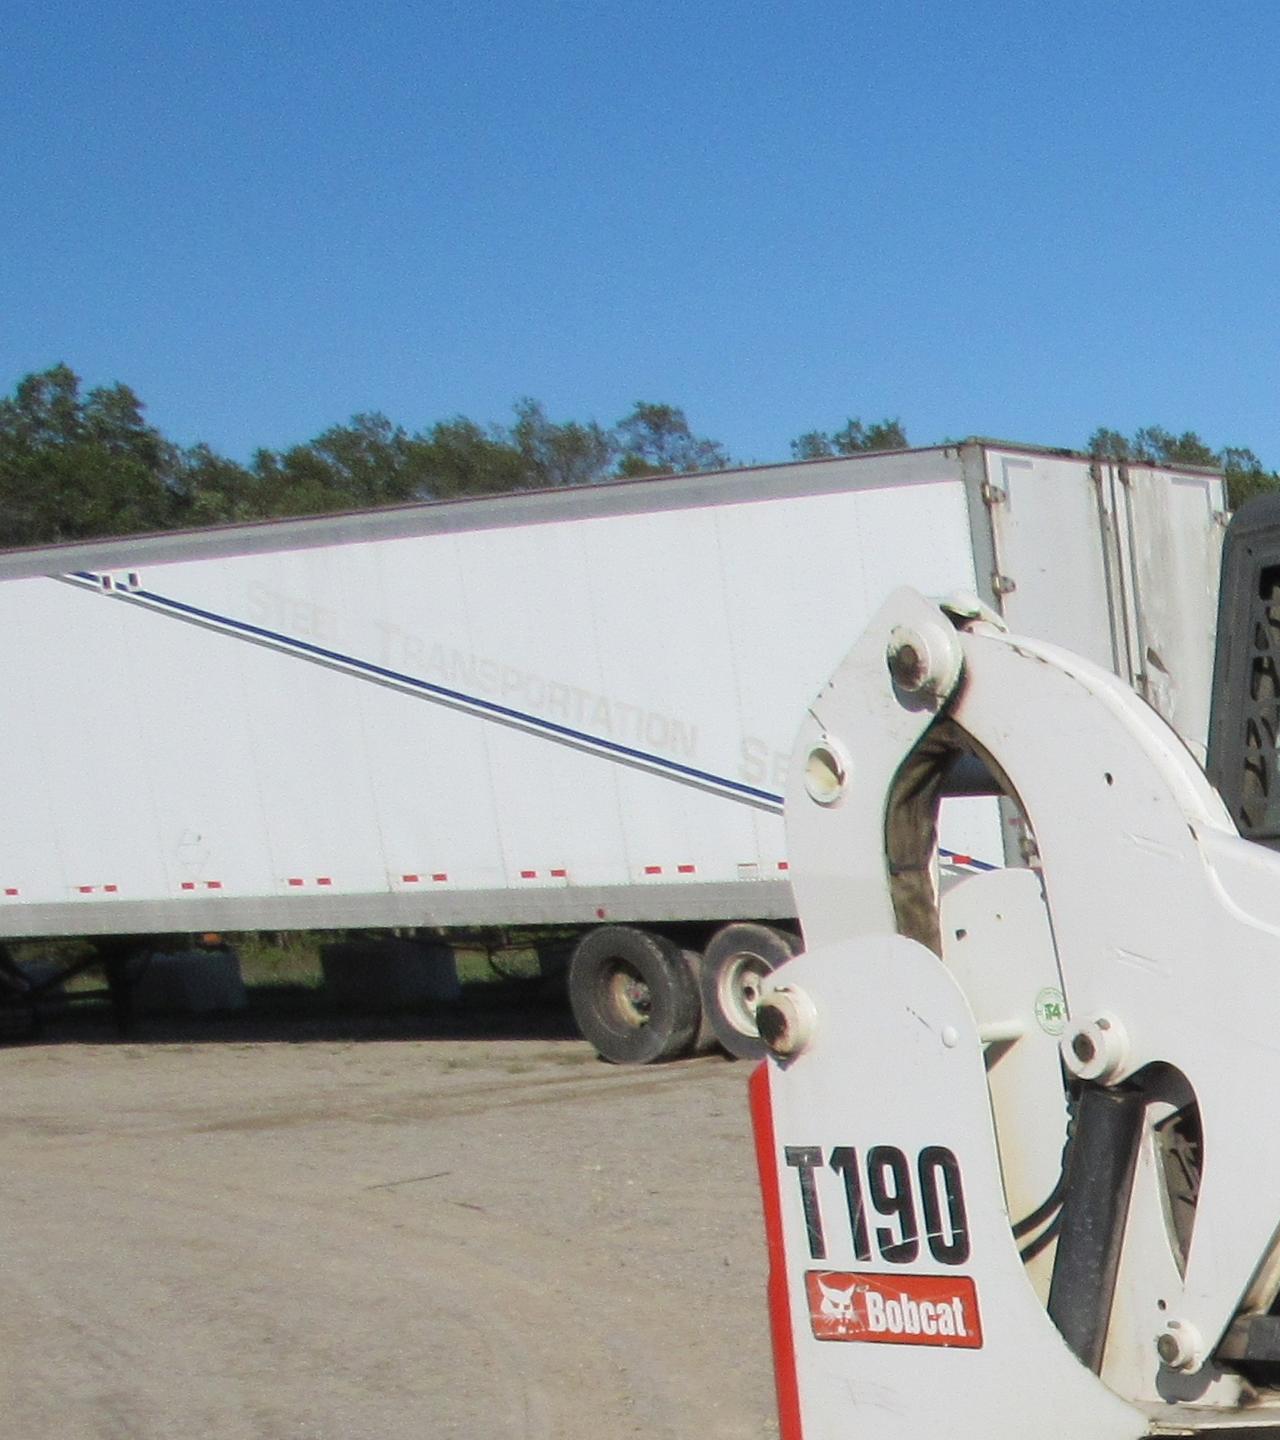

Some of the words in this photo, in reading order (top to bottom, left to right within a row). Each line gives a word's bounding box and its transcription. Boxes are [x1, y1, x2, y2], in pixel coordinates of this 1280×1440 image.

[372, 617, 698, 758] TRANSPORTATION
[784, 1145, 970, 1266] T190
[865, 1291, 967, 1337] Bobcat
